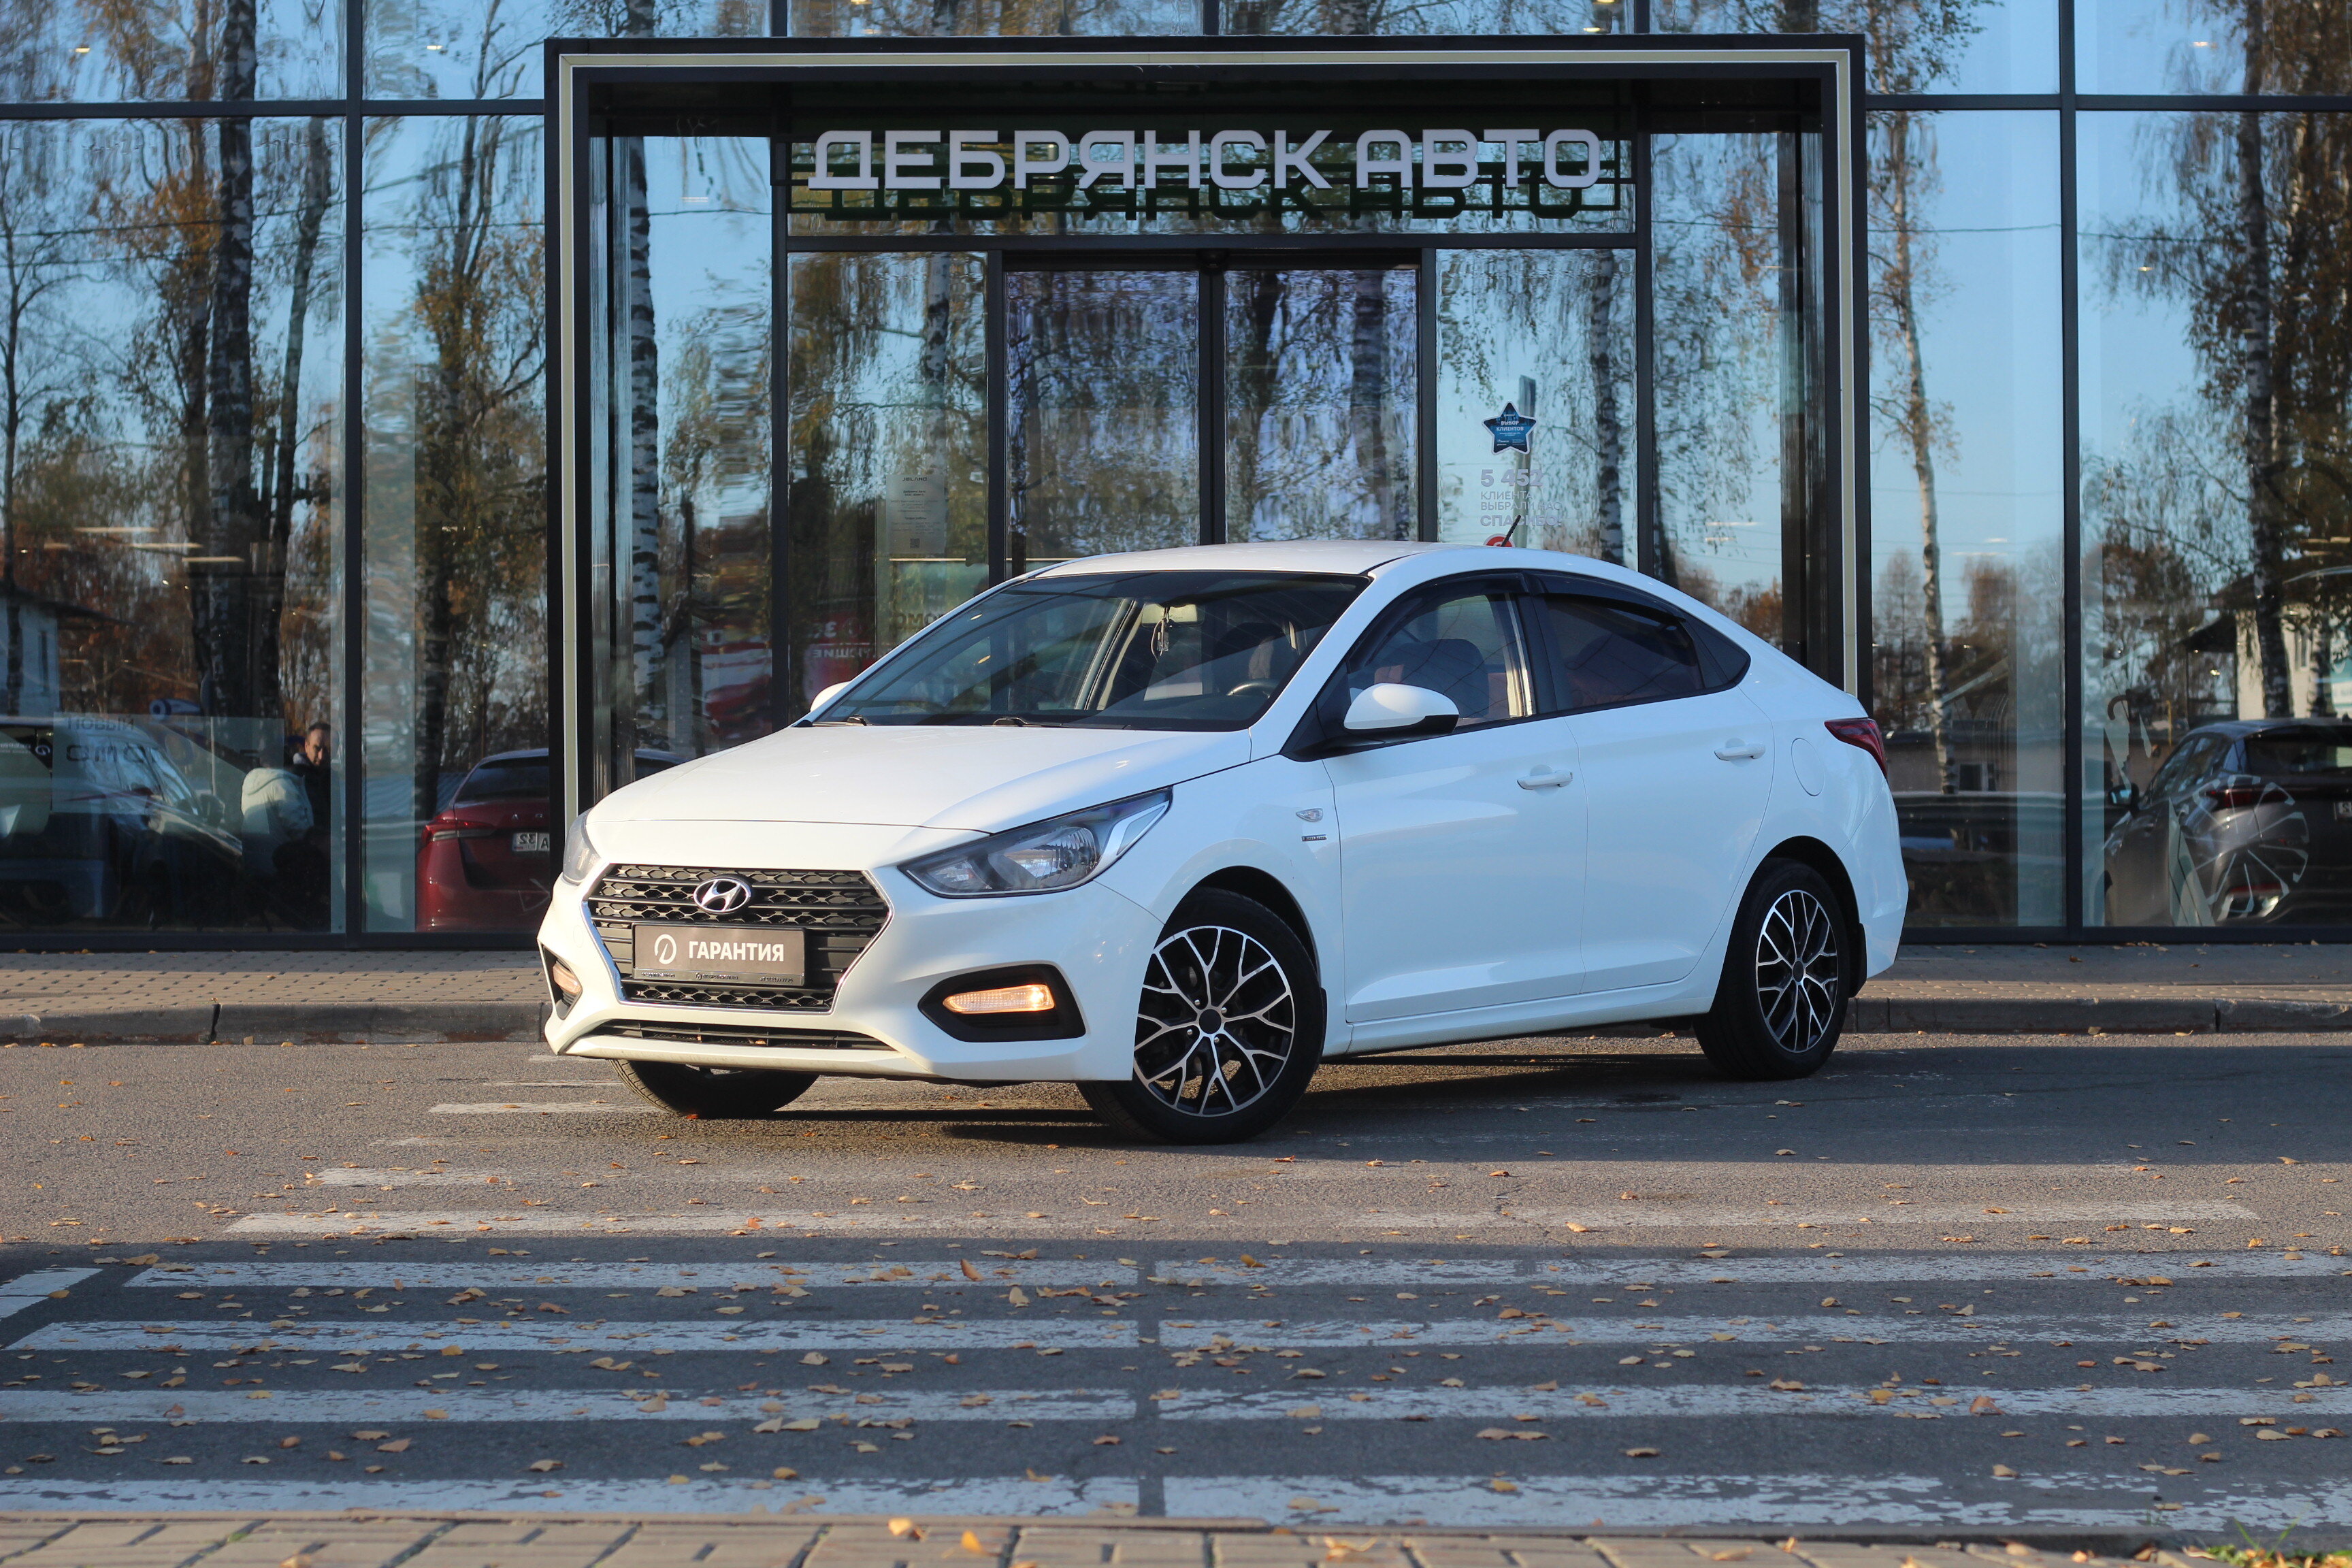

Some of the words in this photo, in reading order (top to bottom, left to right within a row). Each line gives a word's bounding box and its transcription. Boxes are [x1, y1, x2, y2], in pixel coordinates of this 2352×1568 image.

[808, 129, 1333, 189] ДЕБРЯНСК
[1356, 129, 1601, 189] АВТО
[1480, 469, 1494, 487] 5
[1501, 468, 1543, 487] 452
[1481, 491, 1533, 500] КЛИЕНТА
[1481, 501, 1535, 510] ВЫБРАЛИ
[689, 941, 784, 962] ГАРАНТИЯ
